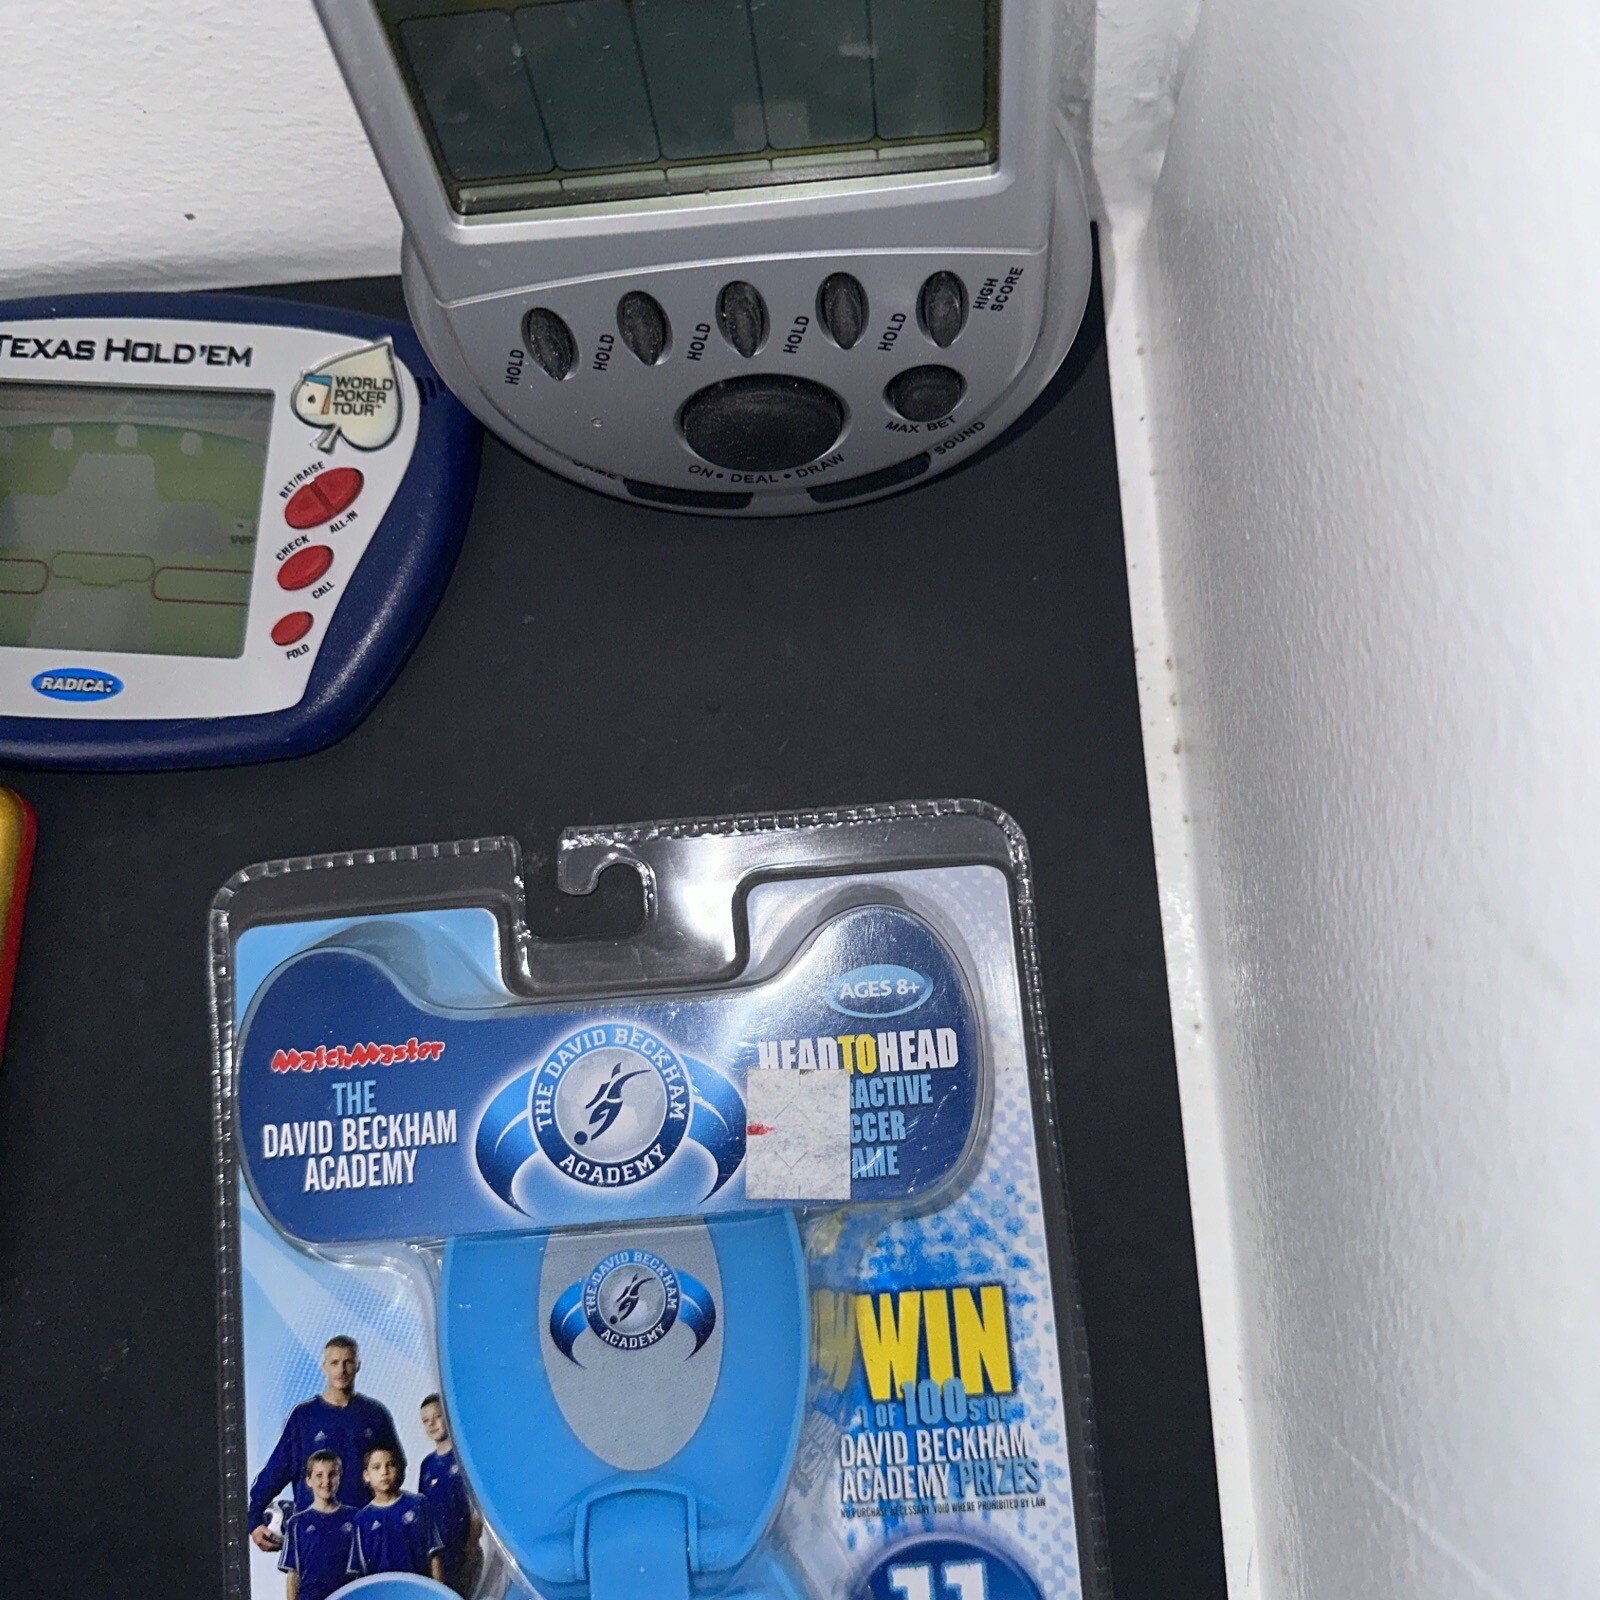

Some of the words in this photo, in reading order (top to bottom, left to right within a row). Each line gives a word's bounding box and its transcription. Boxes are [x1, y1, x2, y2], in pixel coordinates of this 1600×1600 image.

[973, 278, 999, 310] HIGH
[990, 267, 1024, 312] SCORE
[687, 323, 711, 361] HOLD
[783, 315, 810, 354] HOLD
[877, 313, 907, 351] HOLD
[0, 334, 96, 361] TEXAS
[104, 338, 253, 367] HOLD'EM
[505, 349, 525, 385] HOLD
[593, 334, 615, 371] HOLD
[334, 389, 387, 403] POKER
[336, 376, 393, 391] WORLD
[885, 420, 920, 434] MAX
[927, 415, 957, 432] BET
[933, 421, 986, 456] SOUND
[279, 461, 325, 499] BET/RAISE
[688, 464, 714, 478] ON
[730, 472, 779, 484] DEAL
[797, 453, 845, 478] DRAW
[329, 510, 358, 534] ALL-IN
[276, 534, 310, 561] CHECK
[312, 581, 335, 599] CALL
[286, 644, 310, 660] FOLD
[840, 980, 892, 1000] AGES
[897, 979, 919, 995] 8+
[271, 1037, 445, 1074] MatchMaster
[536, 1083, 554, 1131] THE
[545, 1028, 607, 1079] DAVID
[614, 1028, 685, 1120] BECKHAM
[850, 1074, 934, 1109] ACTIVE
[332, 1080, 377, 1116] THE
[263, 1120, 333, 1159] DAVID
[342, 1109, 457, 1152] BECKHAM
[850, 1110, 906, 1143] CCER
[304, 1150, 418, 1192] ACADEMY
[559, 1143, 666, 1184] ACADEMY
[851, 1145, 900, 1178] AME
[586, 1285, 597, 1316] THE
[592, 1251, 629, 1284] DAVID
[633, 1251, 677, 1309] BECKHAM
[600, 1322, 666, 1349] ACADEMY
[855, 1285, 1013, 1401] WIN
[875, 1402, 897, 1427] OF
[840, 1430, 908, 1468] DAVID
[916, 1423, 1029, 1463] BECKHAM
[841, 1463, 950, 1503] ACADEMY
[957, 1458, 1042, 1499] PRIZES
[952, 1501, 975, 1512] WHERE
[978, 1499, 1019, 1511] PROHIBITED
[1021, 1498, 1030, 1508] BY
[1031, 1496, 1046, 1507] LAW
